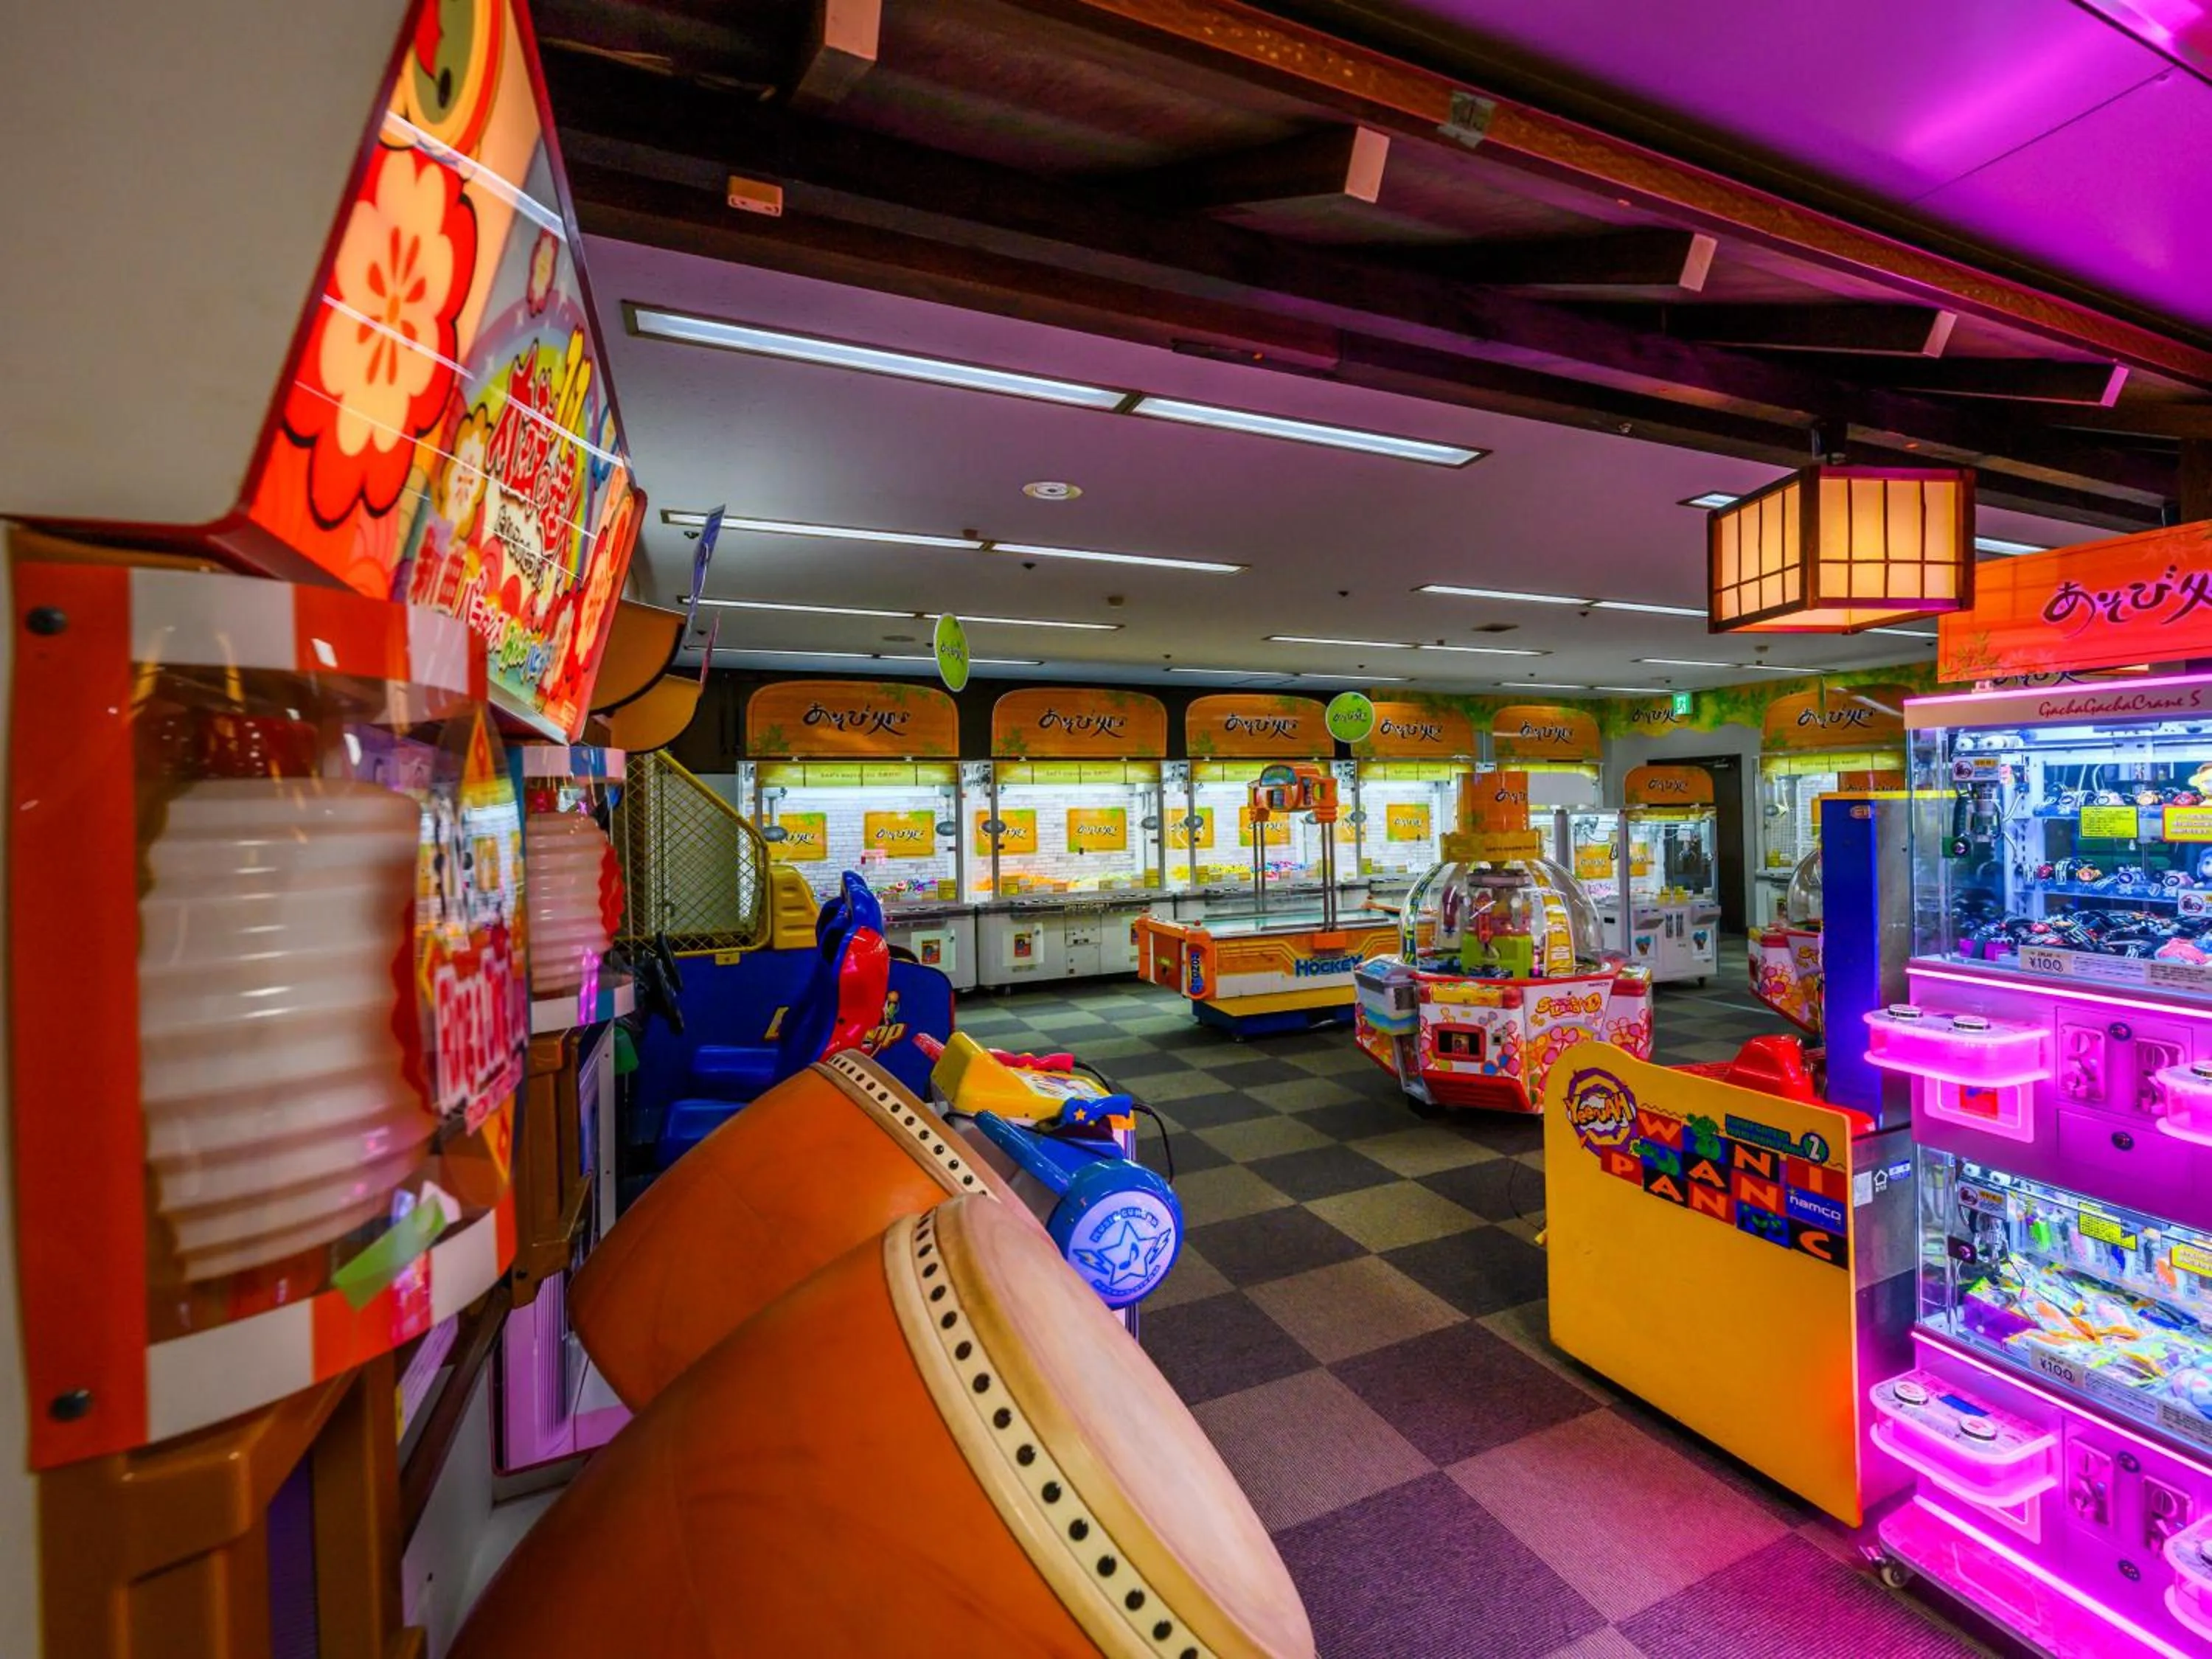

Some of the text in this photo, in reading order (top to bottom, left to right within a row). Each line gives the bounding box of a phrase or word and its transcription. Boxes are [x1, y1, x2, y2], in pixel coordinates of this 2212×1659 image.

[1295, 955, 1363, 978] HOCKEY
[2029, 956, 2063, 972] ¥100
[1790, 1194, 1842, 1221] namco
